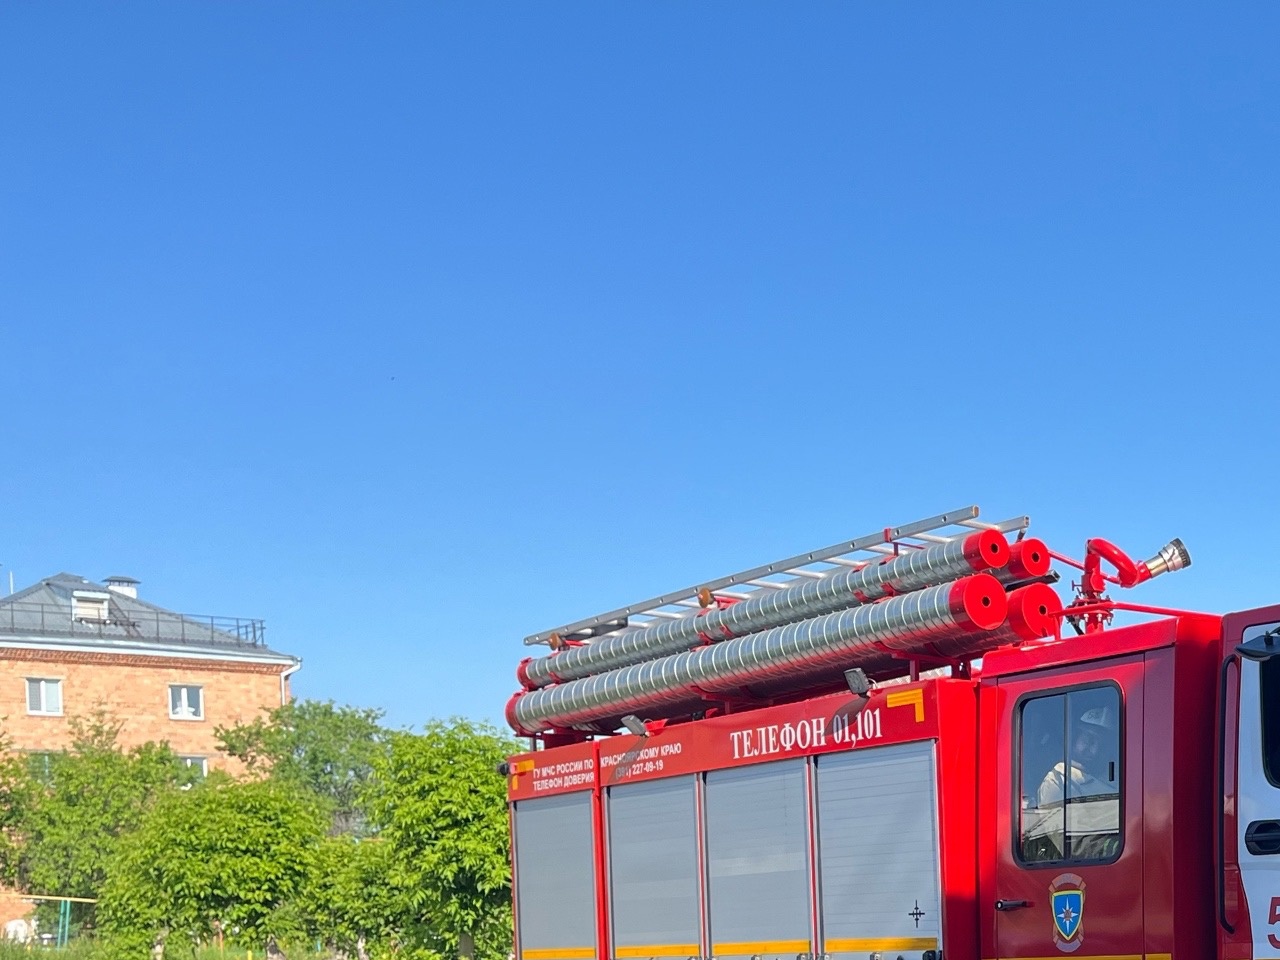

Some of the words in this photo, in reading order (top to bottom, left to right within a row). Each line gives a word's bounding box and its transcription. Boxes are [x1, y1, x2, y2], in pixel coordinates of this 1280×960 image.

[730, 717, 827, 759] ТЕЛЕФОН
[833, 708, 882, 748] 01,101
[533, 768, 541, 778] ГУ
[542, 766, 556, 777] МЧС
[556, 761, 583, 774] РОССИИ
[584, 759, 594, 770] ПО
[660, 743, 682, 757] КРАЮ
[533, 776, 562, 791] ТЕЛЕФОН
[563, 772, 594, 788] ДОВЕРИЯ
[632, 760, 664, 775] 227-09-19
